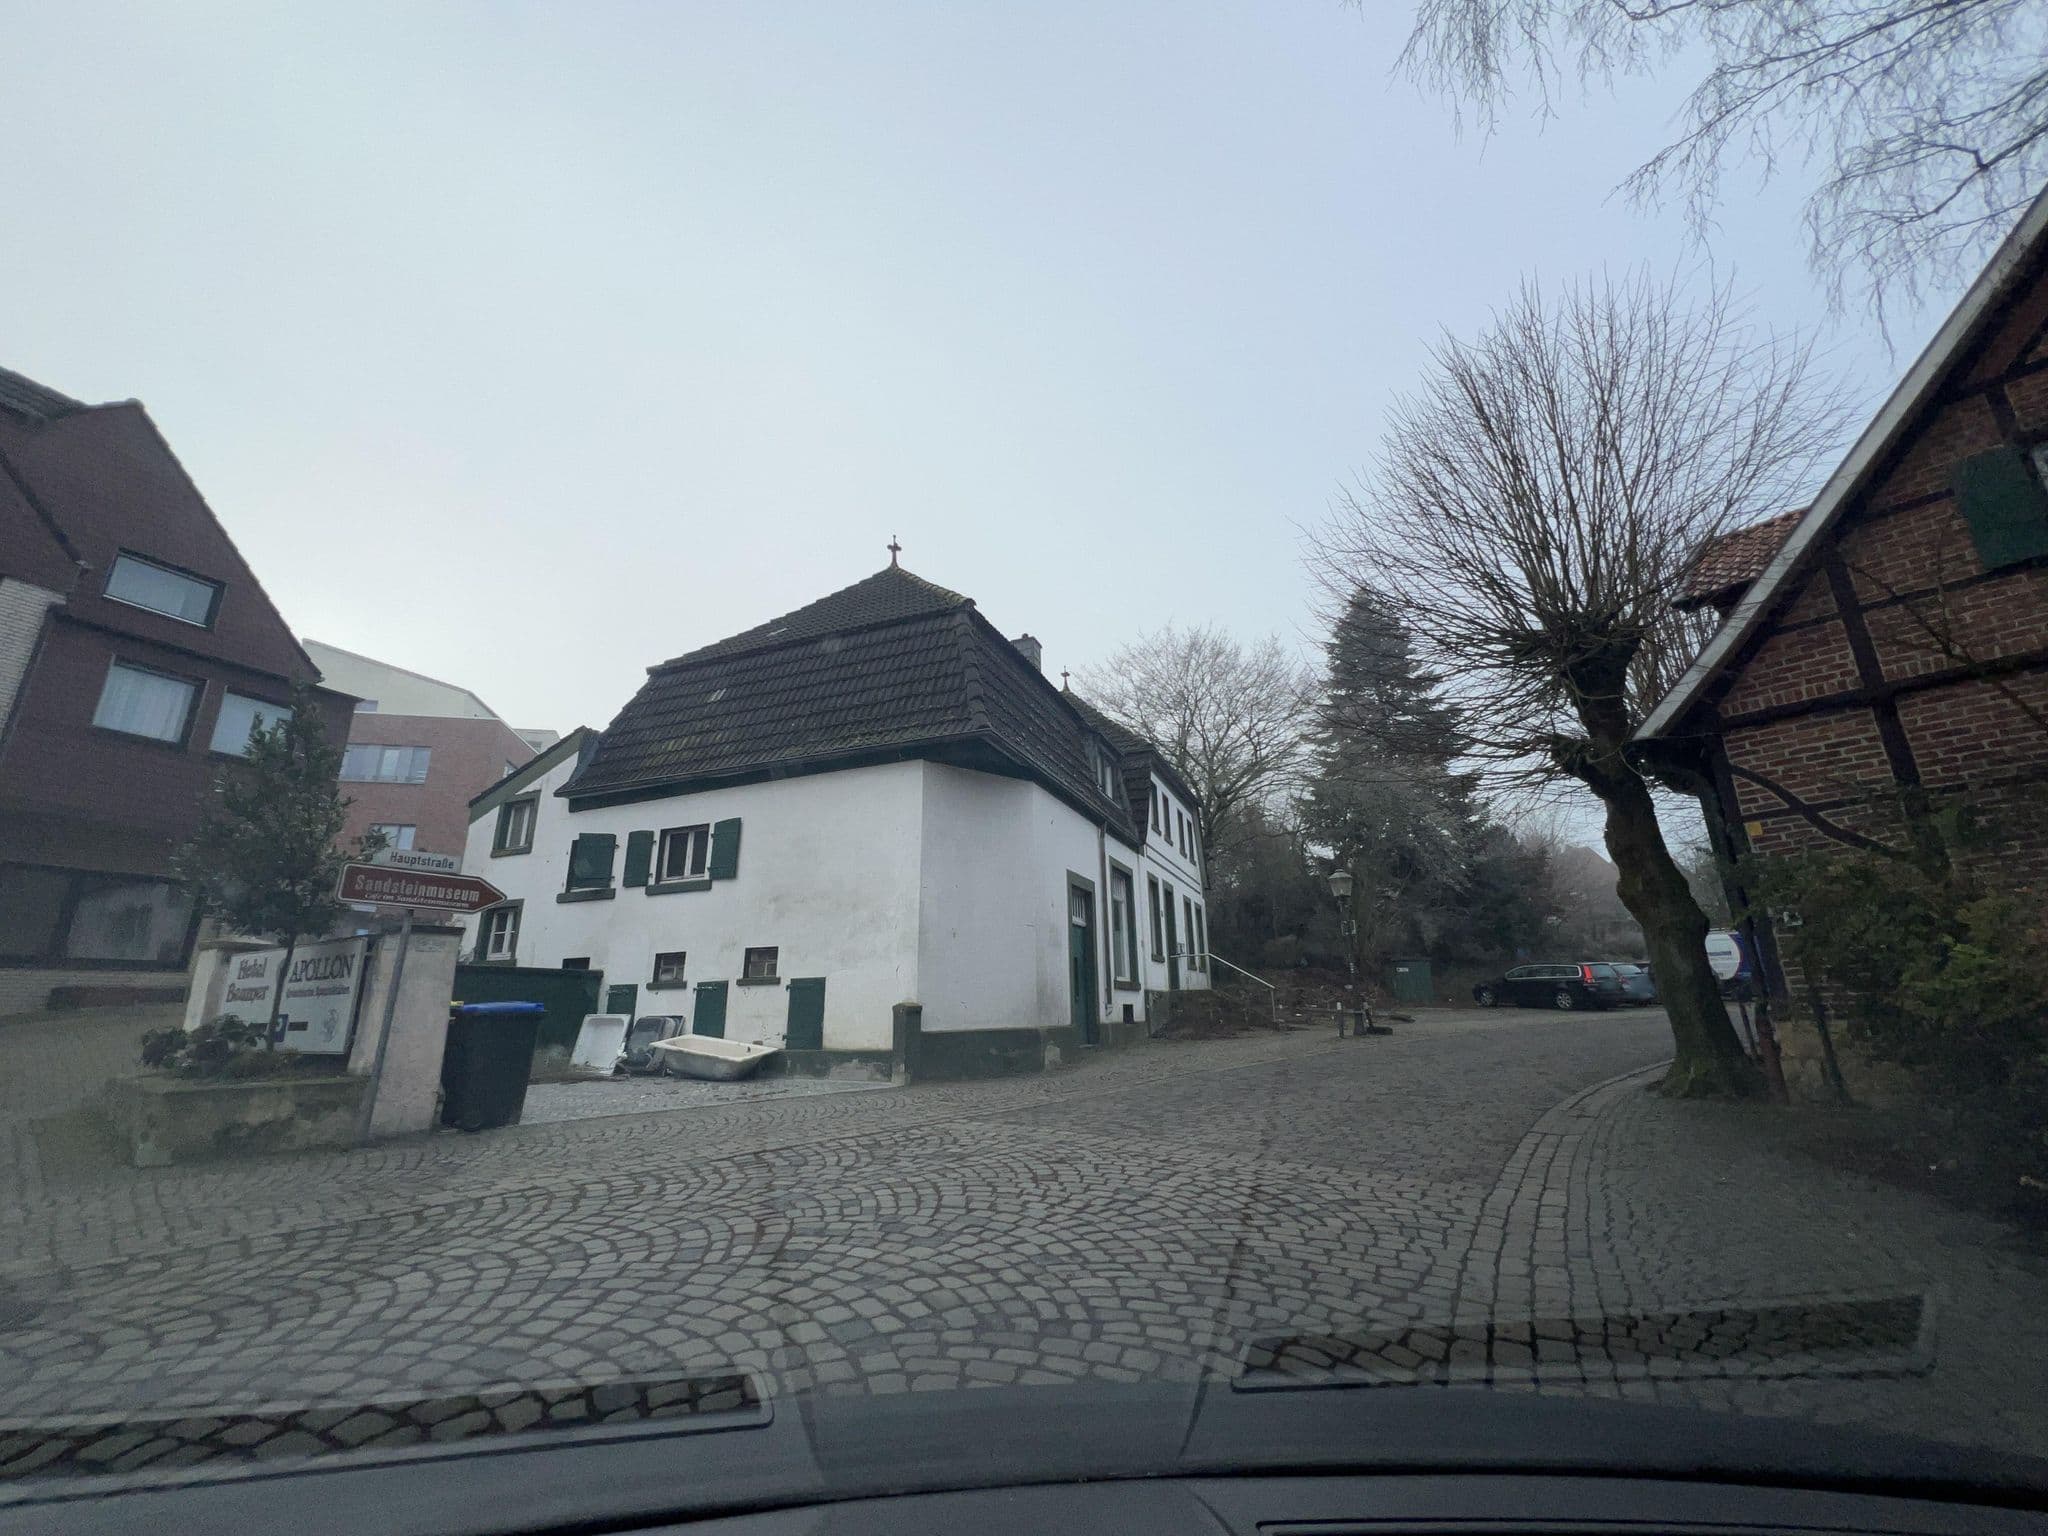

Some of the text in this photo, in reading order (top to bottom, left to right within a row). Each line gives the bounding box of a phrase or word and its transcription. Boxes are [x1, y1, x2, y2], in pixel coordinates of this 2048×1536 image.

[390, 851, 455, 869] Hauptstraße
[355, 874, 481, 903] Sandsteinmuseum
[396, 895, 470, 908] Sandsteinmuseum
[288, 953, 356, 983] APOLLON
